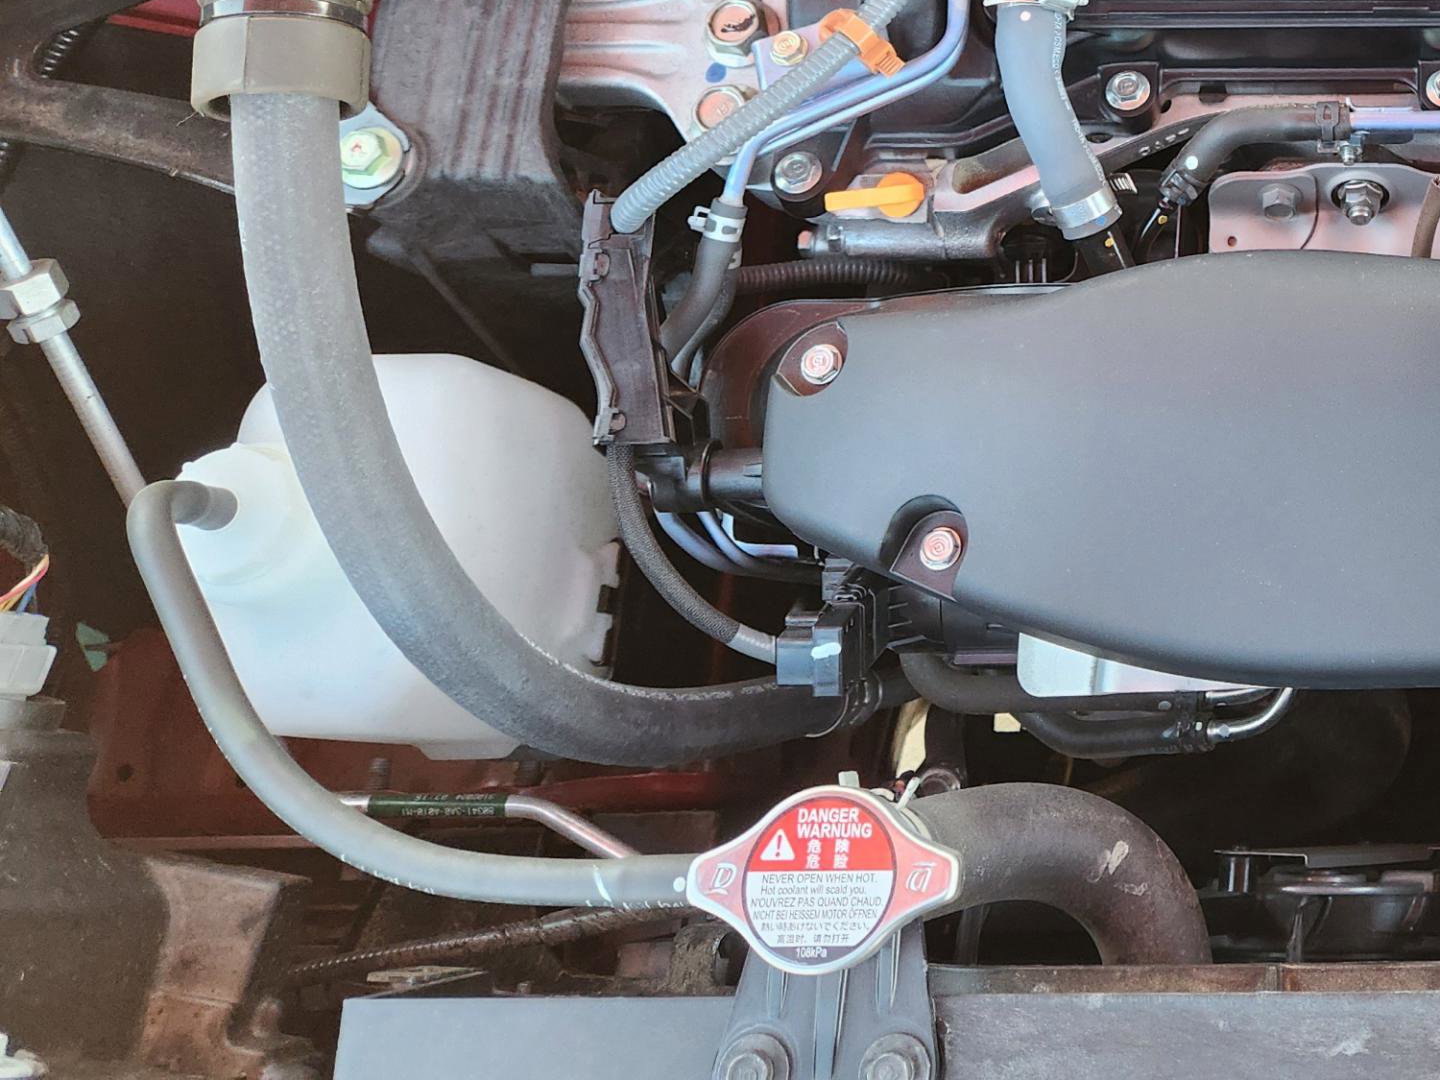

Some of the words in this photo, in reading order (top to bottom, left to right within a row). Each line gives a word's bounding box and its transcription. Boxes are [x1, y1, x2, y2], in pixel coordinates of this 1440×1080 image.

[797, 808, 860, 823] DANGER
[797, 823, 873, 838] WARNUNG
[762, 873, 795, 884] NEVER
[796, 873, 824, 884] OPEN
[825, 873, 854, 883] WHEN
[855, 873, 878, 883] HOT.
[760, 885, 776, 895] Hot
[777, 885, 808, 895] coolant
[810, 885, 824, 894] will
[825, 885, 848, 895] scald
[751, 897, 796, 908] N'OUVREZ
[797, 897, 815, 907] PAS
[817, 897, 848, 907] QUAND
[753, 910, 775, 920] NICHT
[776, 910, 788, 920] BEI
[789, 909, 820, 920] HEISSEM
[821, 909, 847, 920] MOTOR
[795, 947, 828, 958] 108kPa
